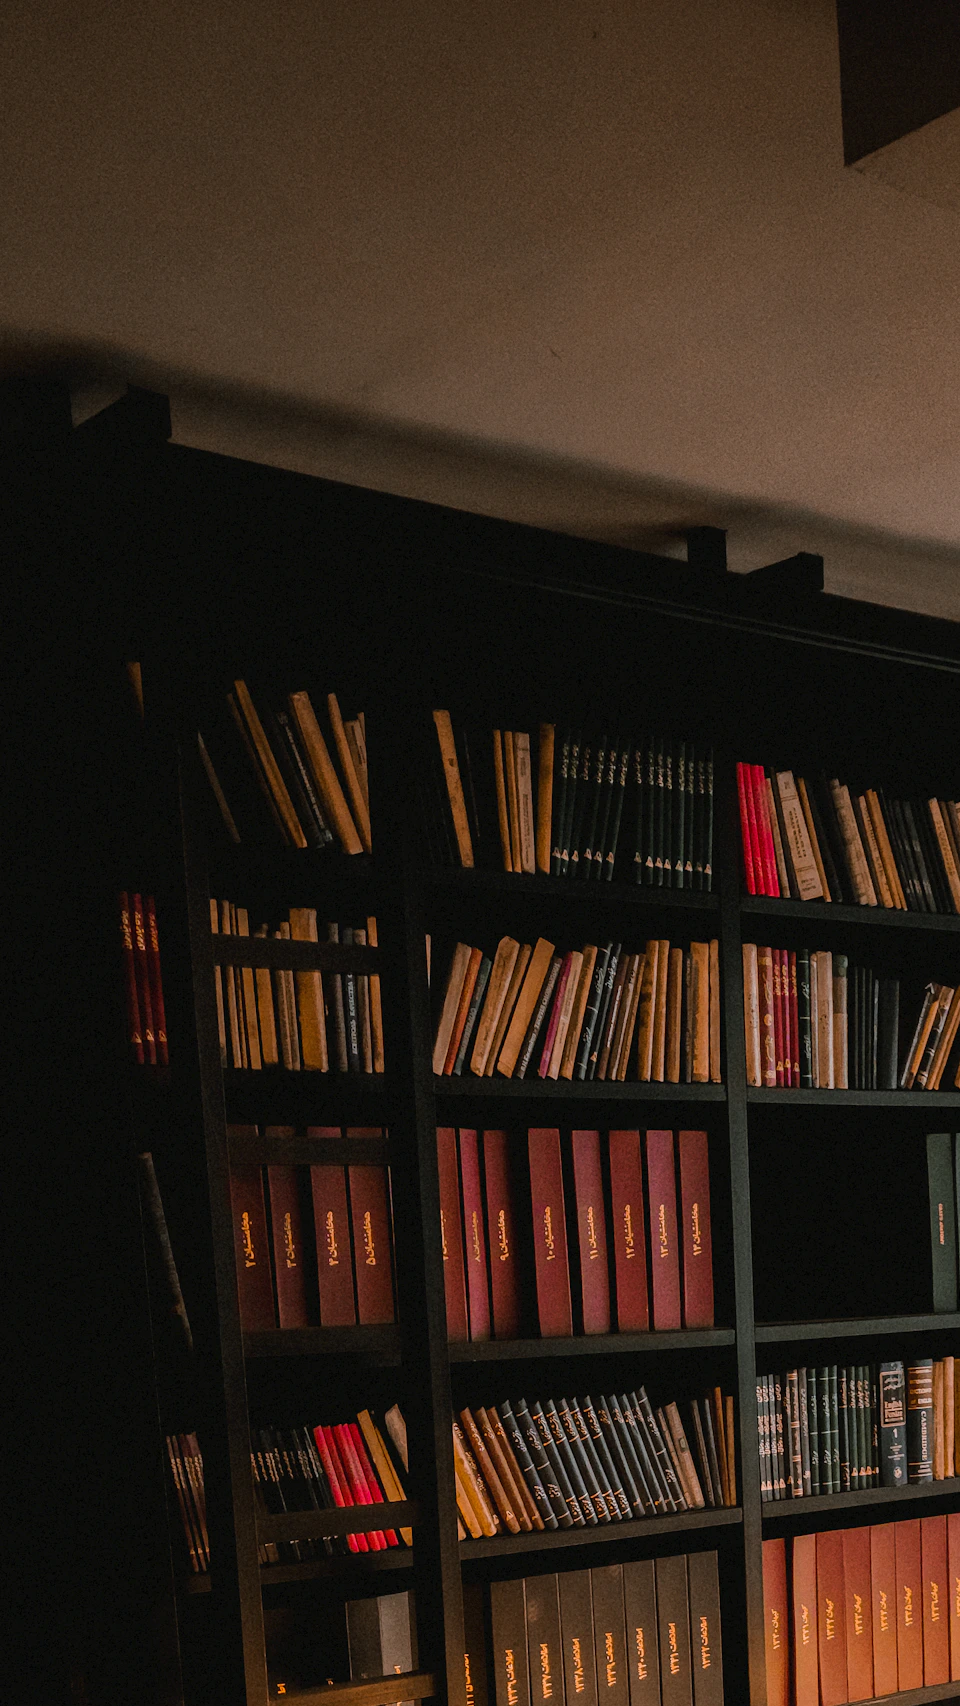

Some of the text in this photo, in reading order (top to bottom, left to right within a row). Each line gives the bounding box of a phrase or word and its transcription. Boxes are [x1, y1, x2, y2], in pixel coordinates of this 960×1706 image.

[467, 1212, 480, 1254] هخامنشیان
[498, 1210, 508, 1251] هخامنشیان
[544, 1207, 554, 1248] هخامنشیان
[587, 1207, 596, 1248] هخامنشیان
[624, 1205, 633, 1246] هخامنشیان
[659, 1204, 667, 1245] هخامنشیان
[692, 1203, 700, 1243] هخامنشیان
[920, 1410, 928, 1461] CAMBRIDGE
[605, 1632, 615, 1662] اطلاعات
[636, 1628, 644, 1657] اطلاعات
[668, 1623, 676, 1651] اطلاعات
[700, 1616, 708, 1645] اطلاعات
[505, 1650, 514, 1679] اطلاعات
[540, 1644, 549, 1673] اطلاعات
[572, 1638, 581, 1667] اطلاعات
